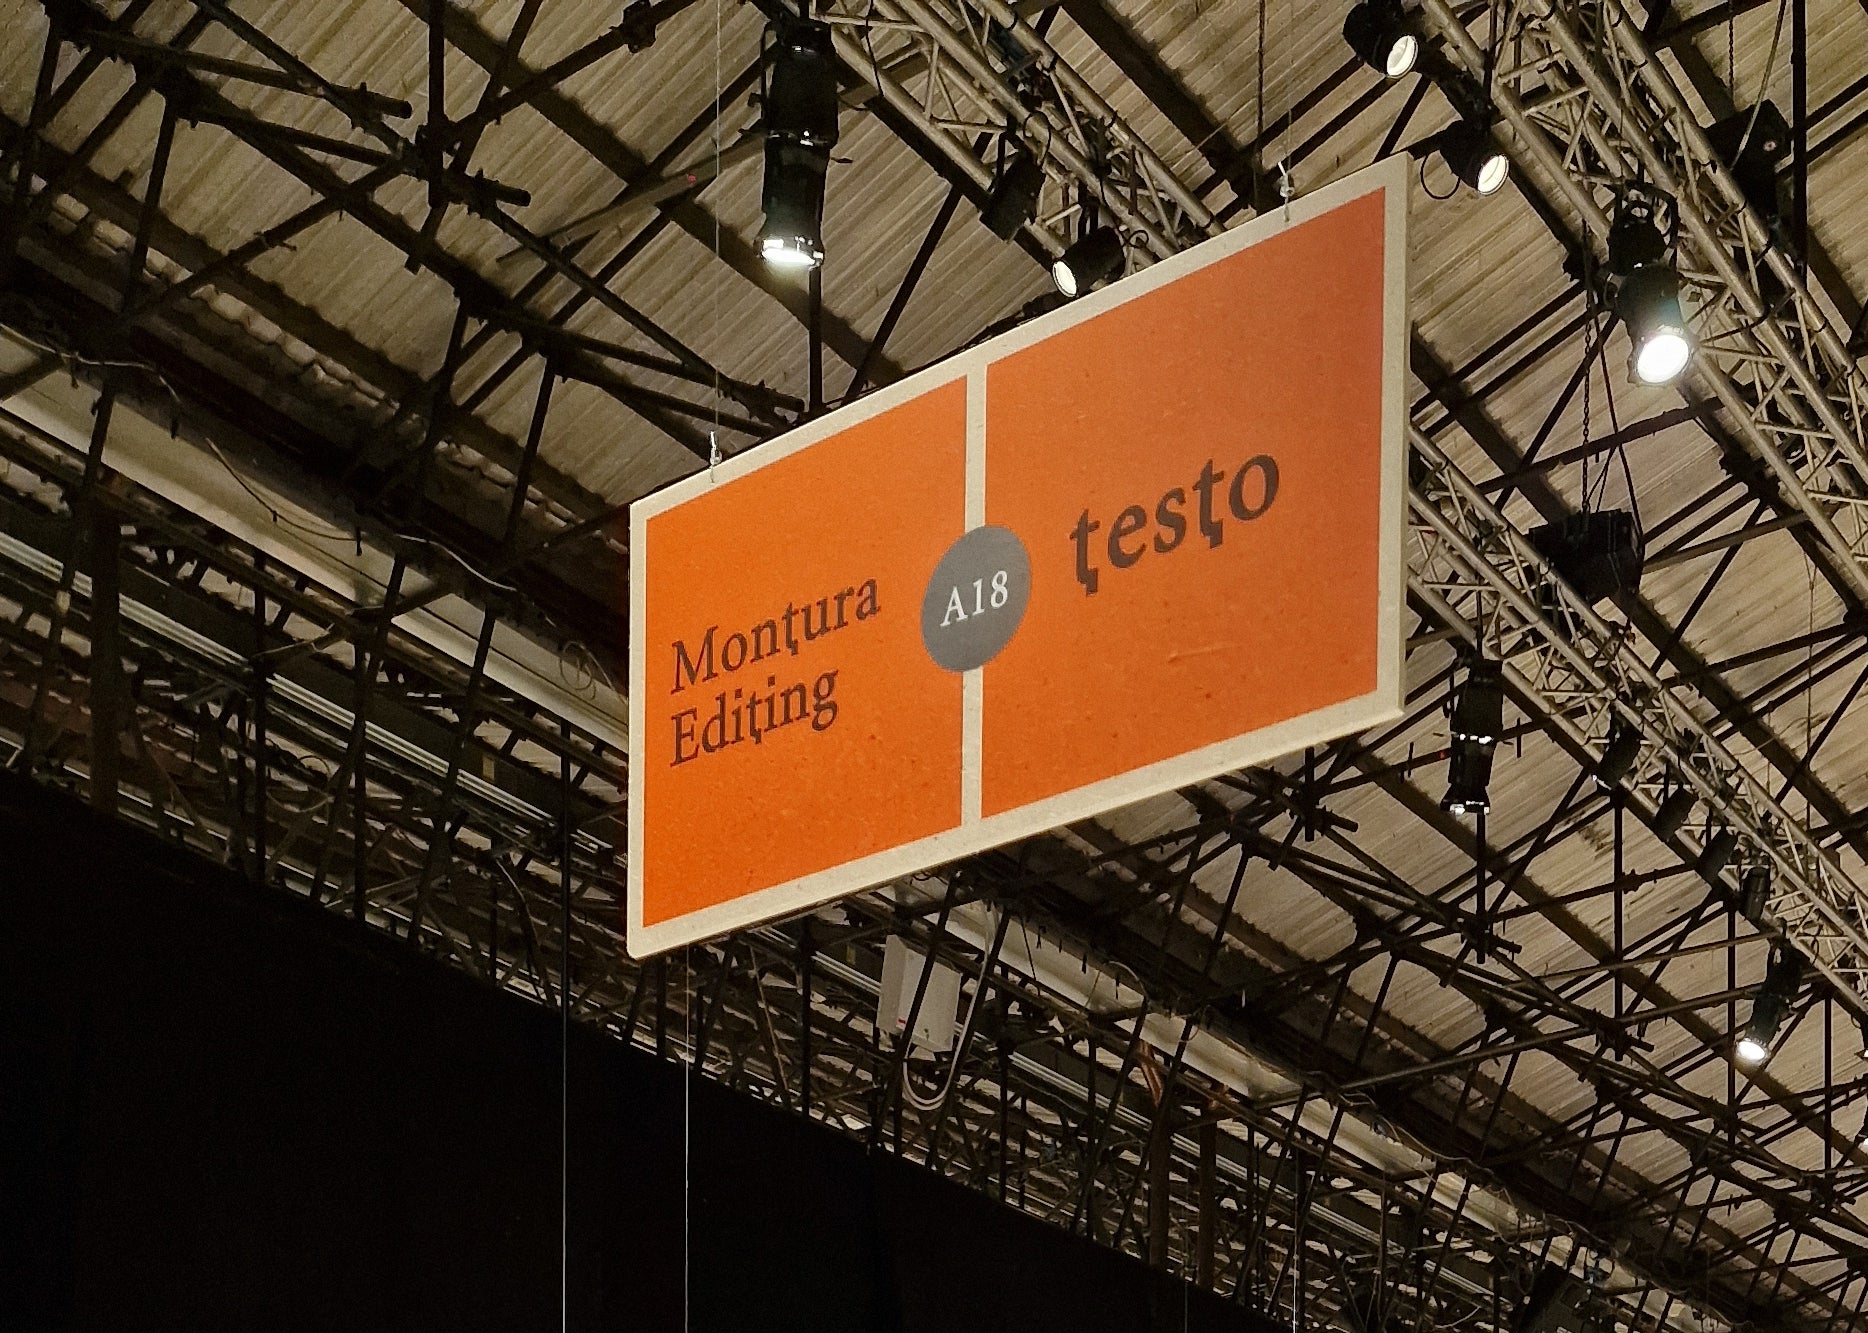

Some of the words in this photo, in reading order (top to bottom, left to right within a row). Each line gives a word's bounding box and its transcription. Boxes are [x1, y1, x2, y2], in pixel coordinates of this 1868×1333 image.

[1069, 452, 1281, 597] testo
[670, 577, 881, 695] Montura
[939, 569, 1009, 628] A18
[669, 668, 839, 768] Editing
